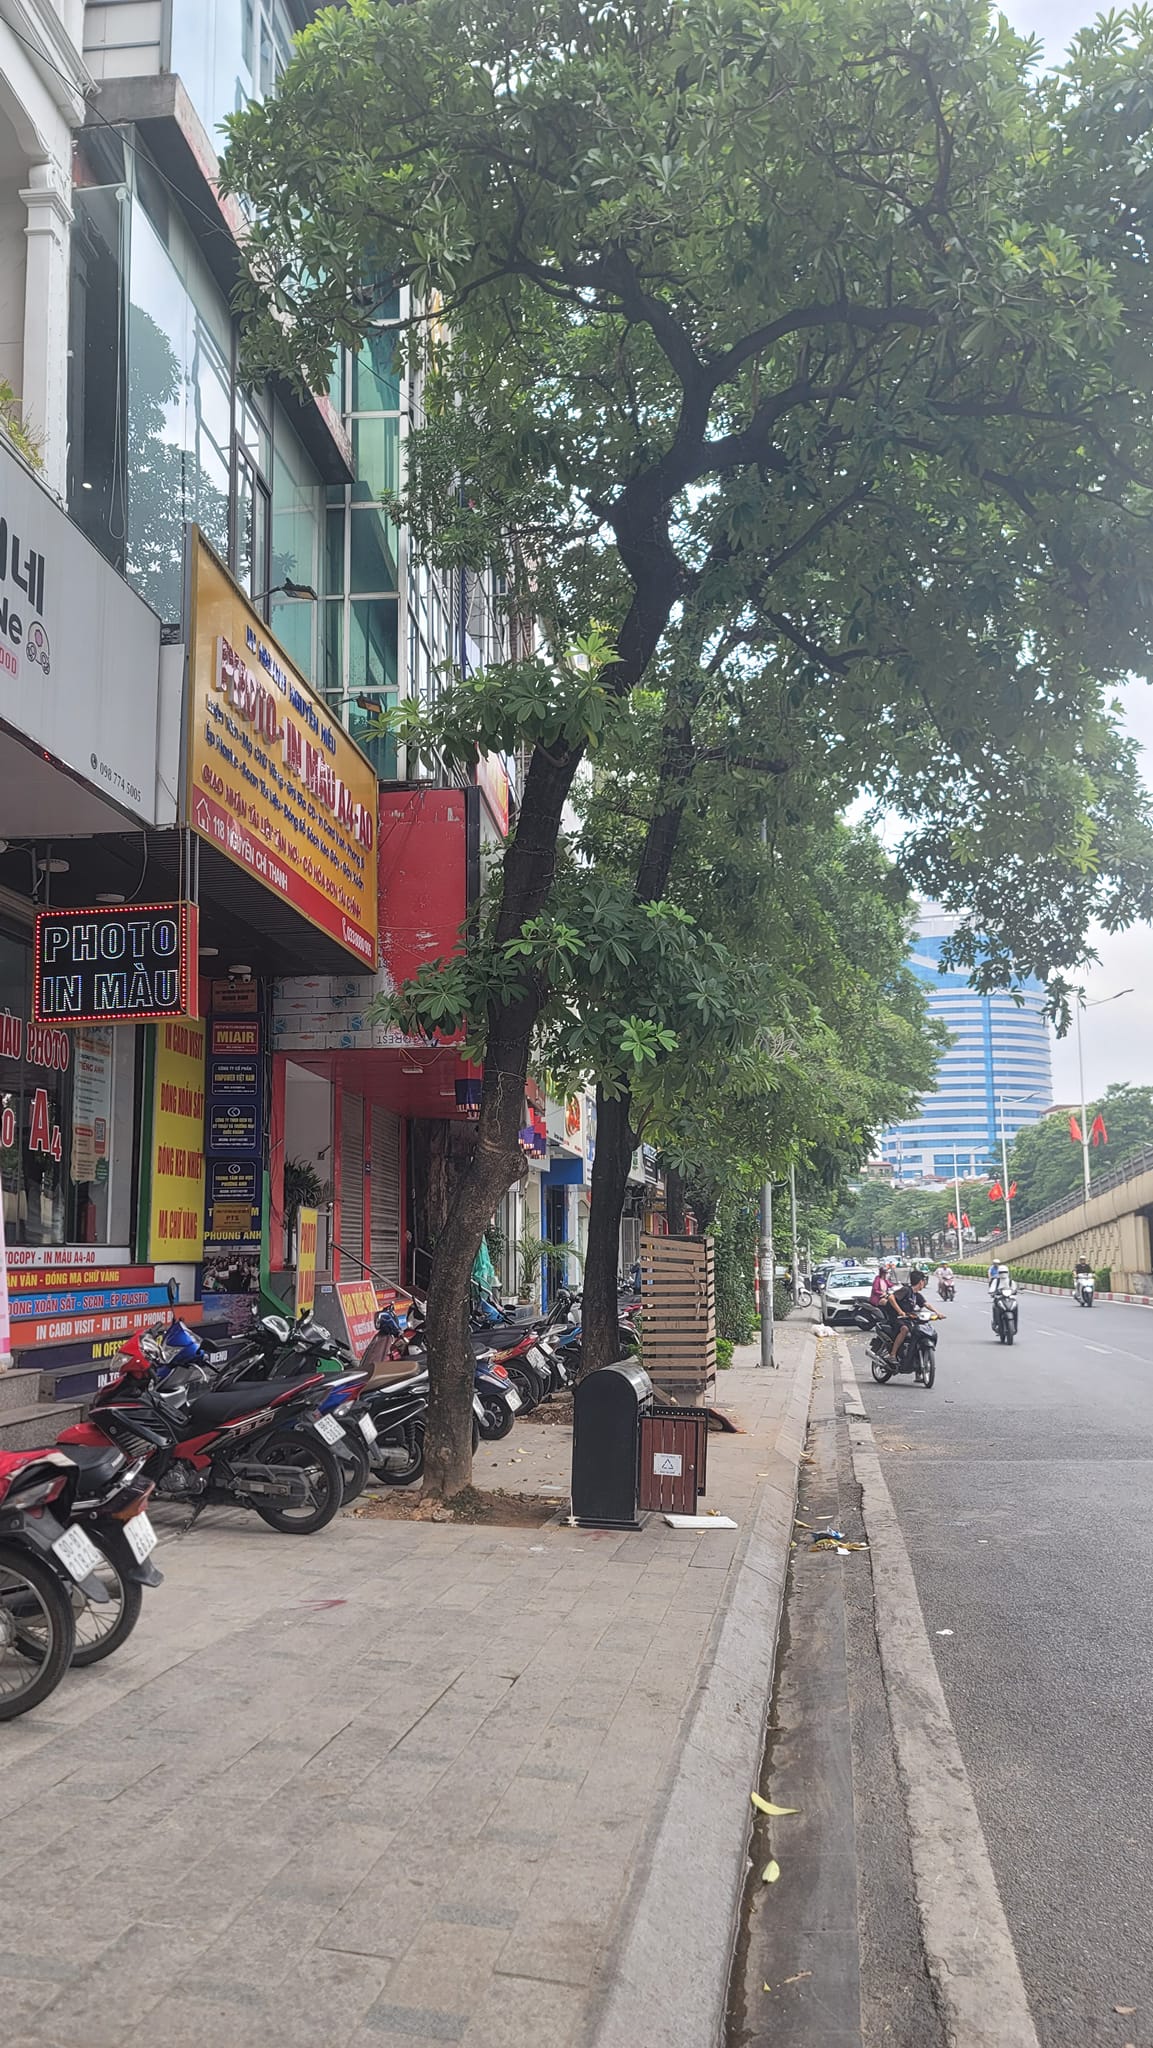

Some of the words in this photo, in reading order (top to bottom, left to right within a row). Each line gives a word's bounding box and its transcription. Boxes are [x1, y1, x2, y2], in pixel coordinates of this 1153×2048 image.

[100, 762, 112, 781] 098
[114, 772, 125, 791] 774
[126, 782, 141, 802] 5005
[213, 815, 225, 841] 118
[227, 826, 254, 866] NGUYỄN
[256, 853, 267, 876] CHÍ
[269, 860, 287, 892] THANH
[44, 919, 178, 962] PHOTO
[42, 975, 82, 1013] IN
[94, 962, 178, 1010] MÀU
[26, 1021, 69, 1072] PHOTO
[217, 1031, 254, 1043] MIAIR
[160, 1080, 177, 1114] ĐÓNG
[158, 1142, 174, 1175] ĐÓNG
[175, 1148, 186, 1178] KEO
[183, 1207, 198, 1240] VÀNG
[44, 1251, 52, 1264] IN
[55, 1248, 72, 1264] MÀU
[20, 1272, 38, 1286] VĂN
[45, 1271, 68, 1285] ĐÓNG
[70, 1272, 82, 1286] MẠ
[84, 1269, 99, 1283] CHỮ
[99, 1269, 119, 1282] VÀNG
[35, 1294, 58, 1313] XOẮN
[60, 1293, 76, 1311] SẮT
[83, 1295, 104, 1309] SCAN
[110, 1291, 120, 1306] ÉP
[121, 1292, 149, 1305] PLASTIC
[36, 1325, 46, 1340] IN
[49, 1321, 72, 1338] CARD
[74, 1319, 95, 1335] VISIT
[102, 1318, 110, 1331] IN
[112, 1315, 128, 1329] TEM
[133, 1314, 142, 1327] IN
[143, 1311, 166, 1326] PHONG
[92, 1343, 101, 1358] IN
